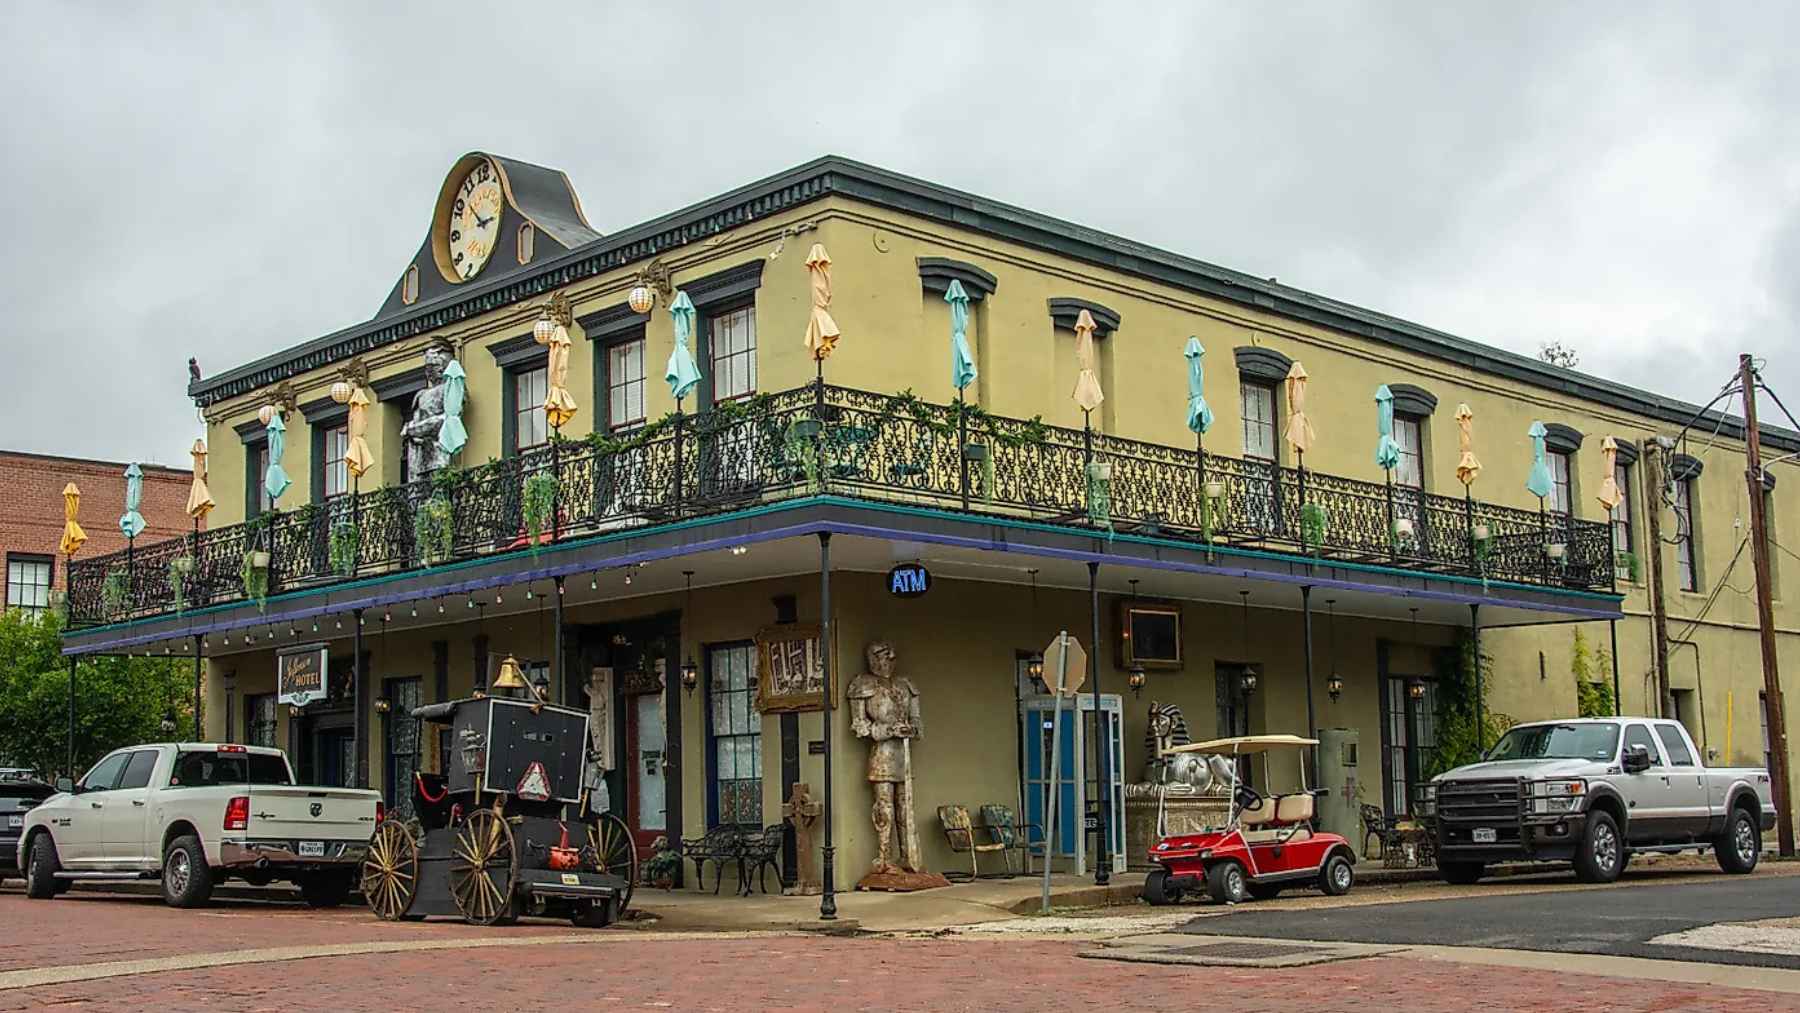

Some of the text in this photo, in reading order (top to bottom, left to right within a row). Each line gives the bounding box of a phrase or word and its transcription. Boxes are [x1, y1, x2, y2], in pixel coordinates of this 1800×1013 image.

[454, 198, 465, 220] 10
[451, 230, 461, 243] 9
[892, 569, 926, 592] ATM
[295, 672, 321, 687] HOTEL
